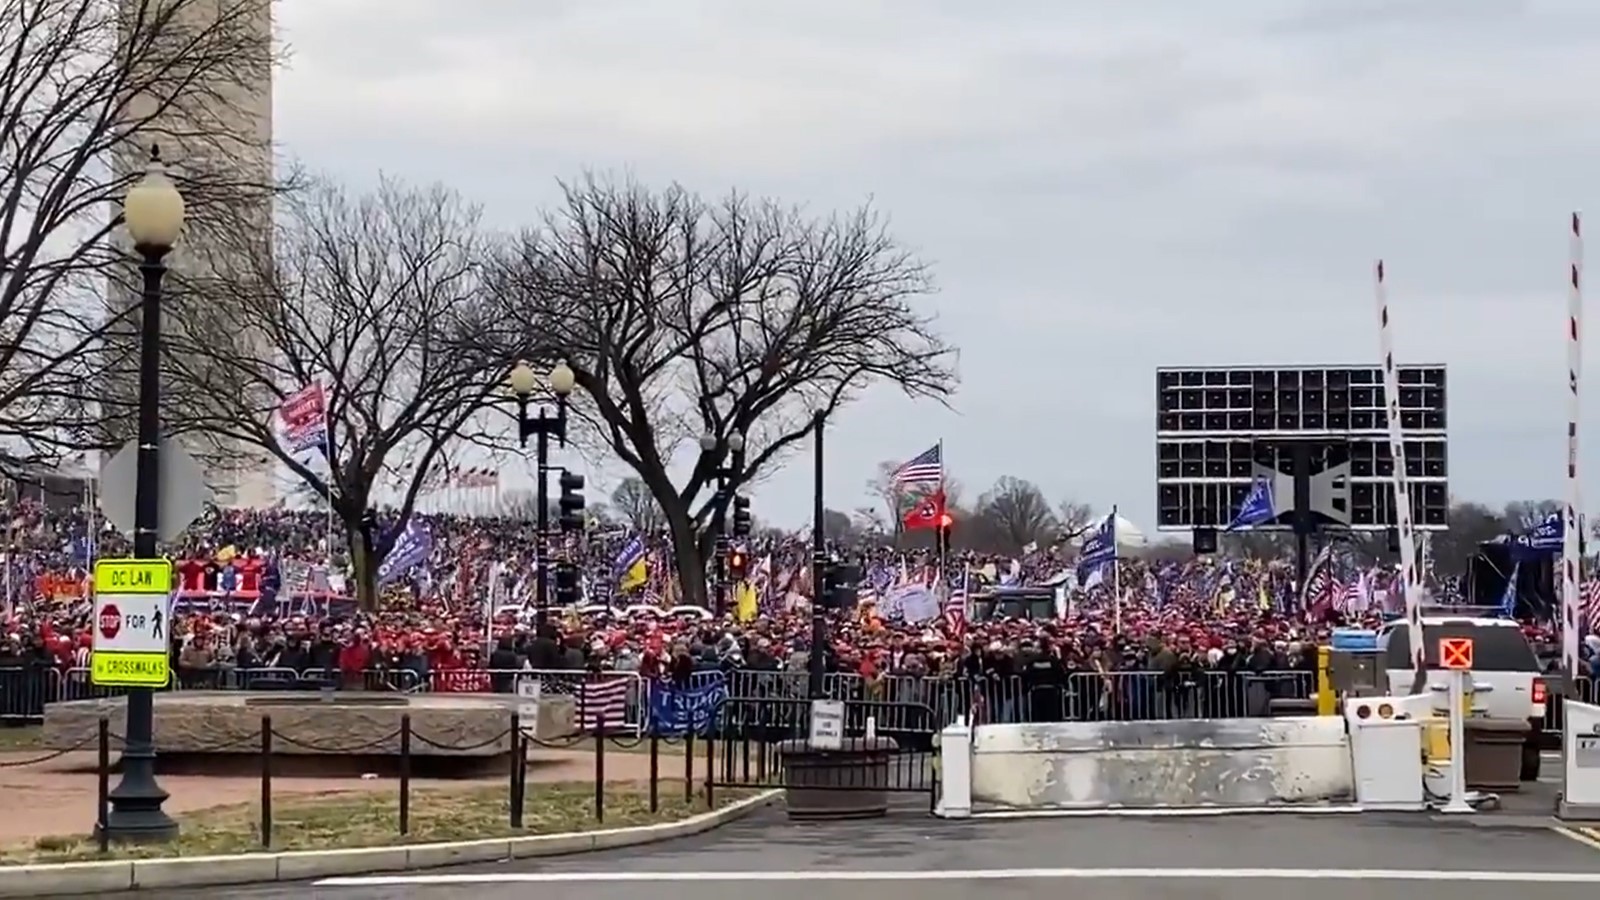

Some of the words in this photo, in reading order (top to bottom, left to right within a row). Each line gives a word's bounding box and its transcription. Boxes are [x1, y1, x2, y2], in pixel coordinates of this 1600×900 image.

[111, 571, 127, 586] DC
[130, 571, 152, 586] LAW
[100, 614, 121, 629] STOP
[126, 615, 146, 629] FOR
[107, 660, 164, 675] CROSSWALKS
[659, 686, 722, 711] TRUMP
